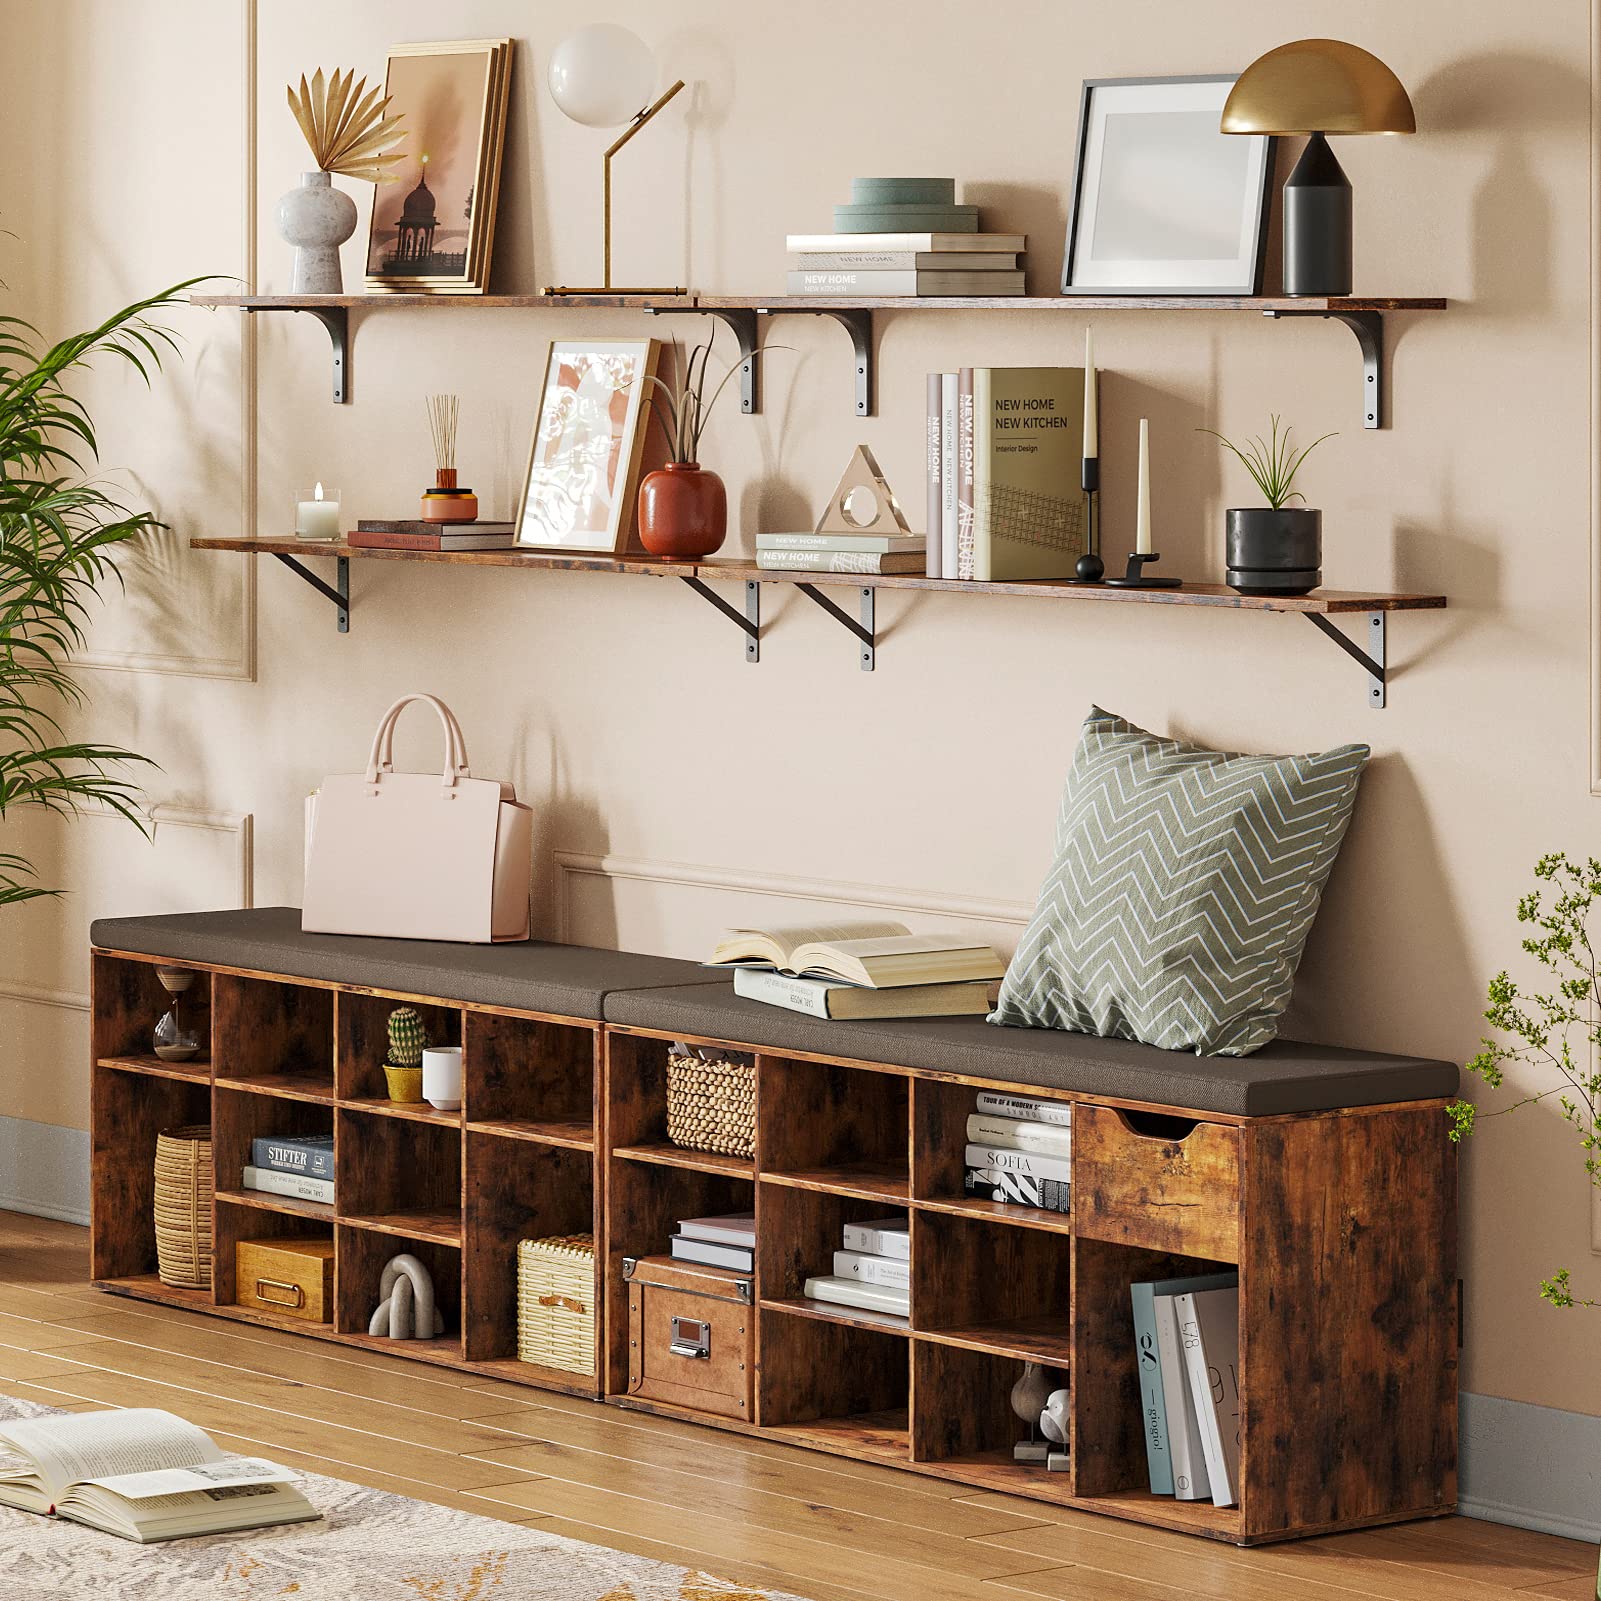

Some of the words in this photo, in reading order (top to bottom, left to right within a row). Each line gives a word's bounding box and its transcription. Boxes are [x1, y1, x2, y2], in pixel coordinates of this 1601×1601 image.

[804, 275, 827, 284] NEW
[828, 275, 857, 284] HOME
[965, 394, 973, 430] NEW
[995, 399, 1021, 411] NEW
[1023, 399, 1055, 410] HOME
[932, 416, 940, 445] NEW
[995, 418, 1021, 429] NEW
[1023, 417, 1068, 429] KITCHEN
[995, 444, 1018, 453] Interior
[1018, 444, 1038, 454] Design
[932, 447, 940, 484] HOME
[965, 436, 973, 486] HOME
[763, 551, 790, 561] NEW
[791, 553, 820, 562] HOME
[983, 1096, 998, 1105] TOUR
[998, 1098, 1006, 1106] OF
[1011, 1100, 1033, 1110] MODERN
[268, 1146, 308, 1166] STIFTER
[987, 1151, 1032, 1172] SOFIA
[1148, 1408, 1163, 1451] giogio!
